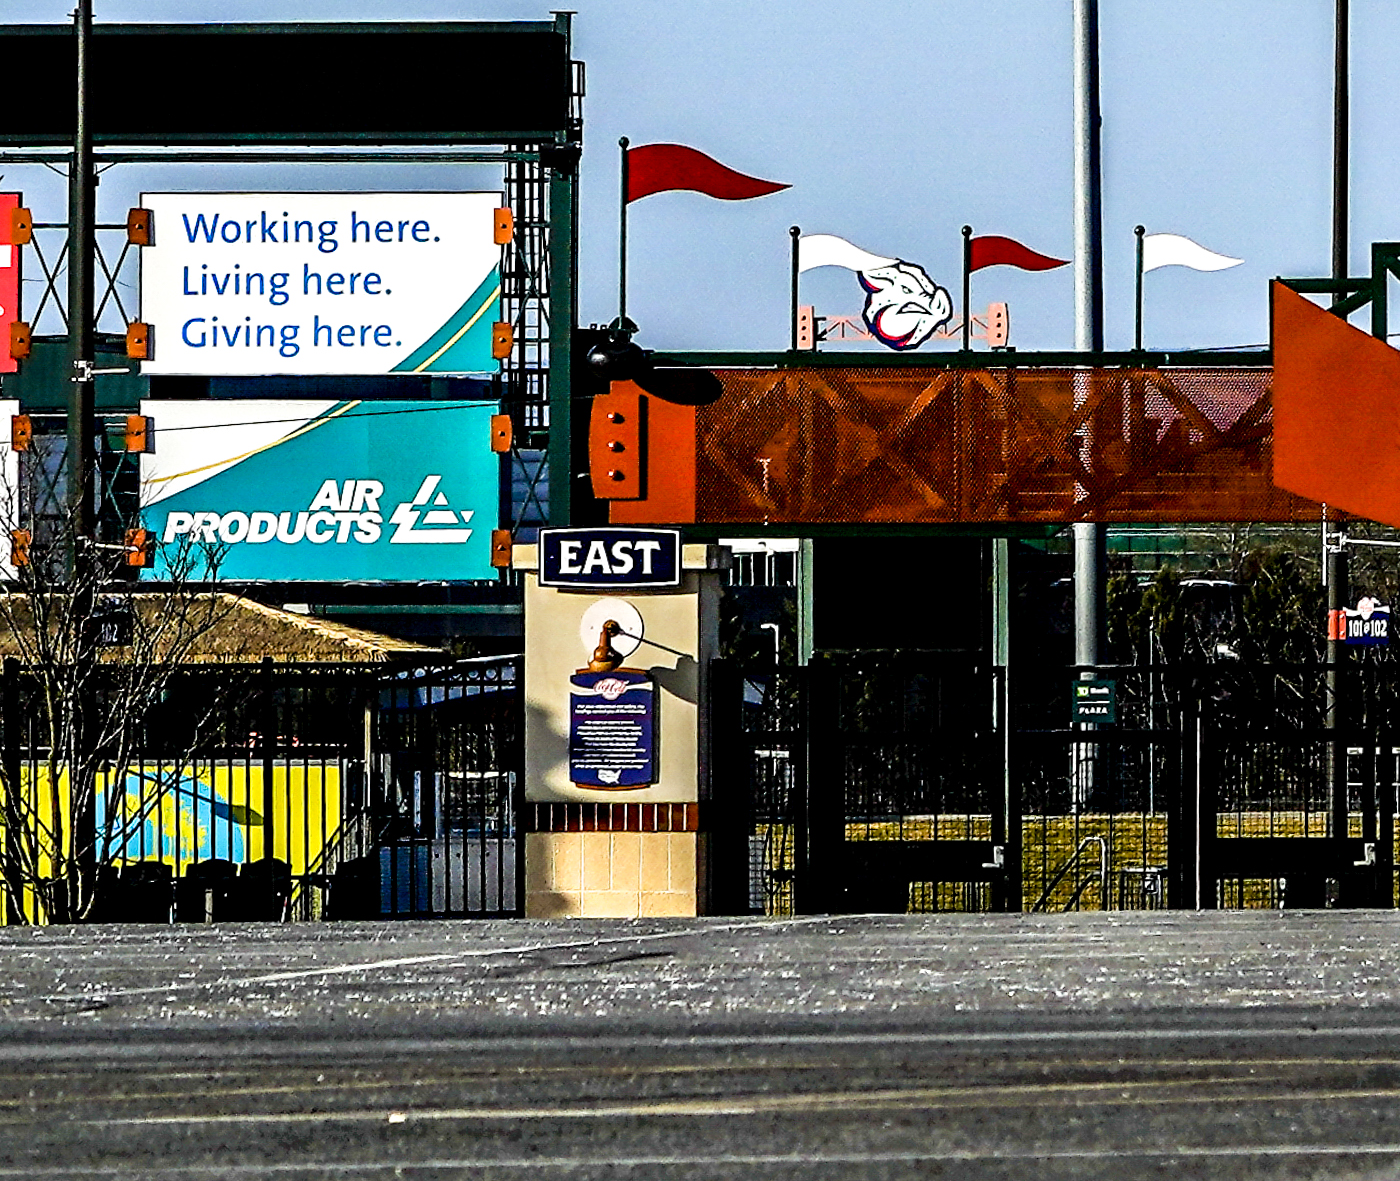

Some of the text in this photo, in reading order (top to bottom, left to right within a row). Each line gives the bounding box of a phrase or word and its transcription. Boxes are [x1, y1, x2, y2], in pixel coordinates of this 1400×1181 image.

[182, 211, 441, 253] Working here.
[183, 264, 392, 305] Living here.
[181, 315, 402, 357] Giving here.
[309, 479, 384, 512] AIR
[163, 510, 384, 544] PRODUCTS
[558, 540, 661, 576] EAST
